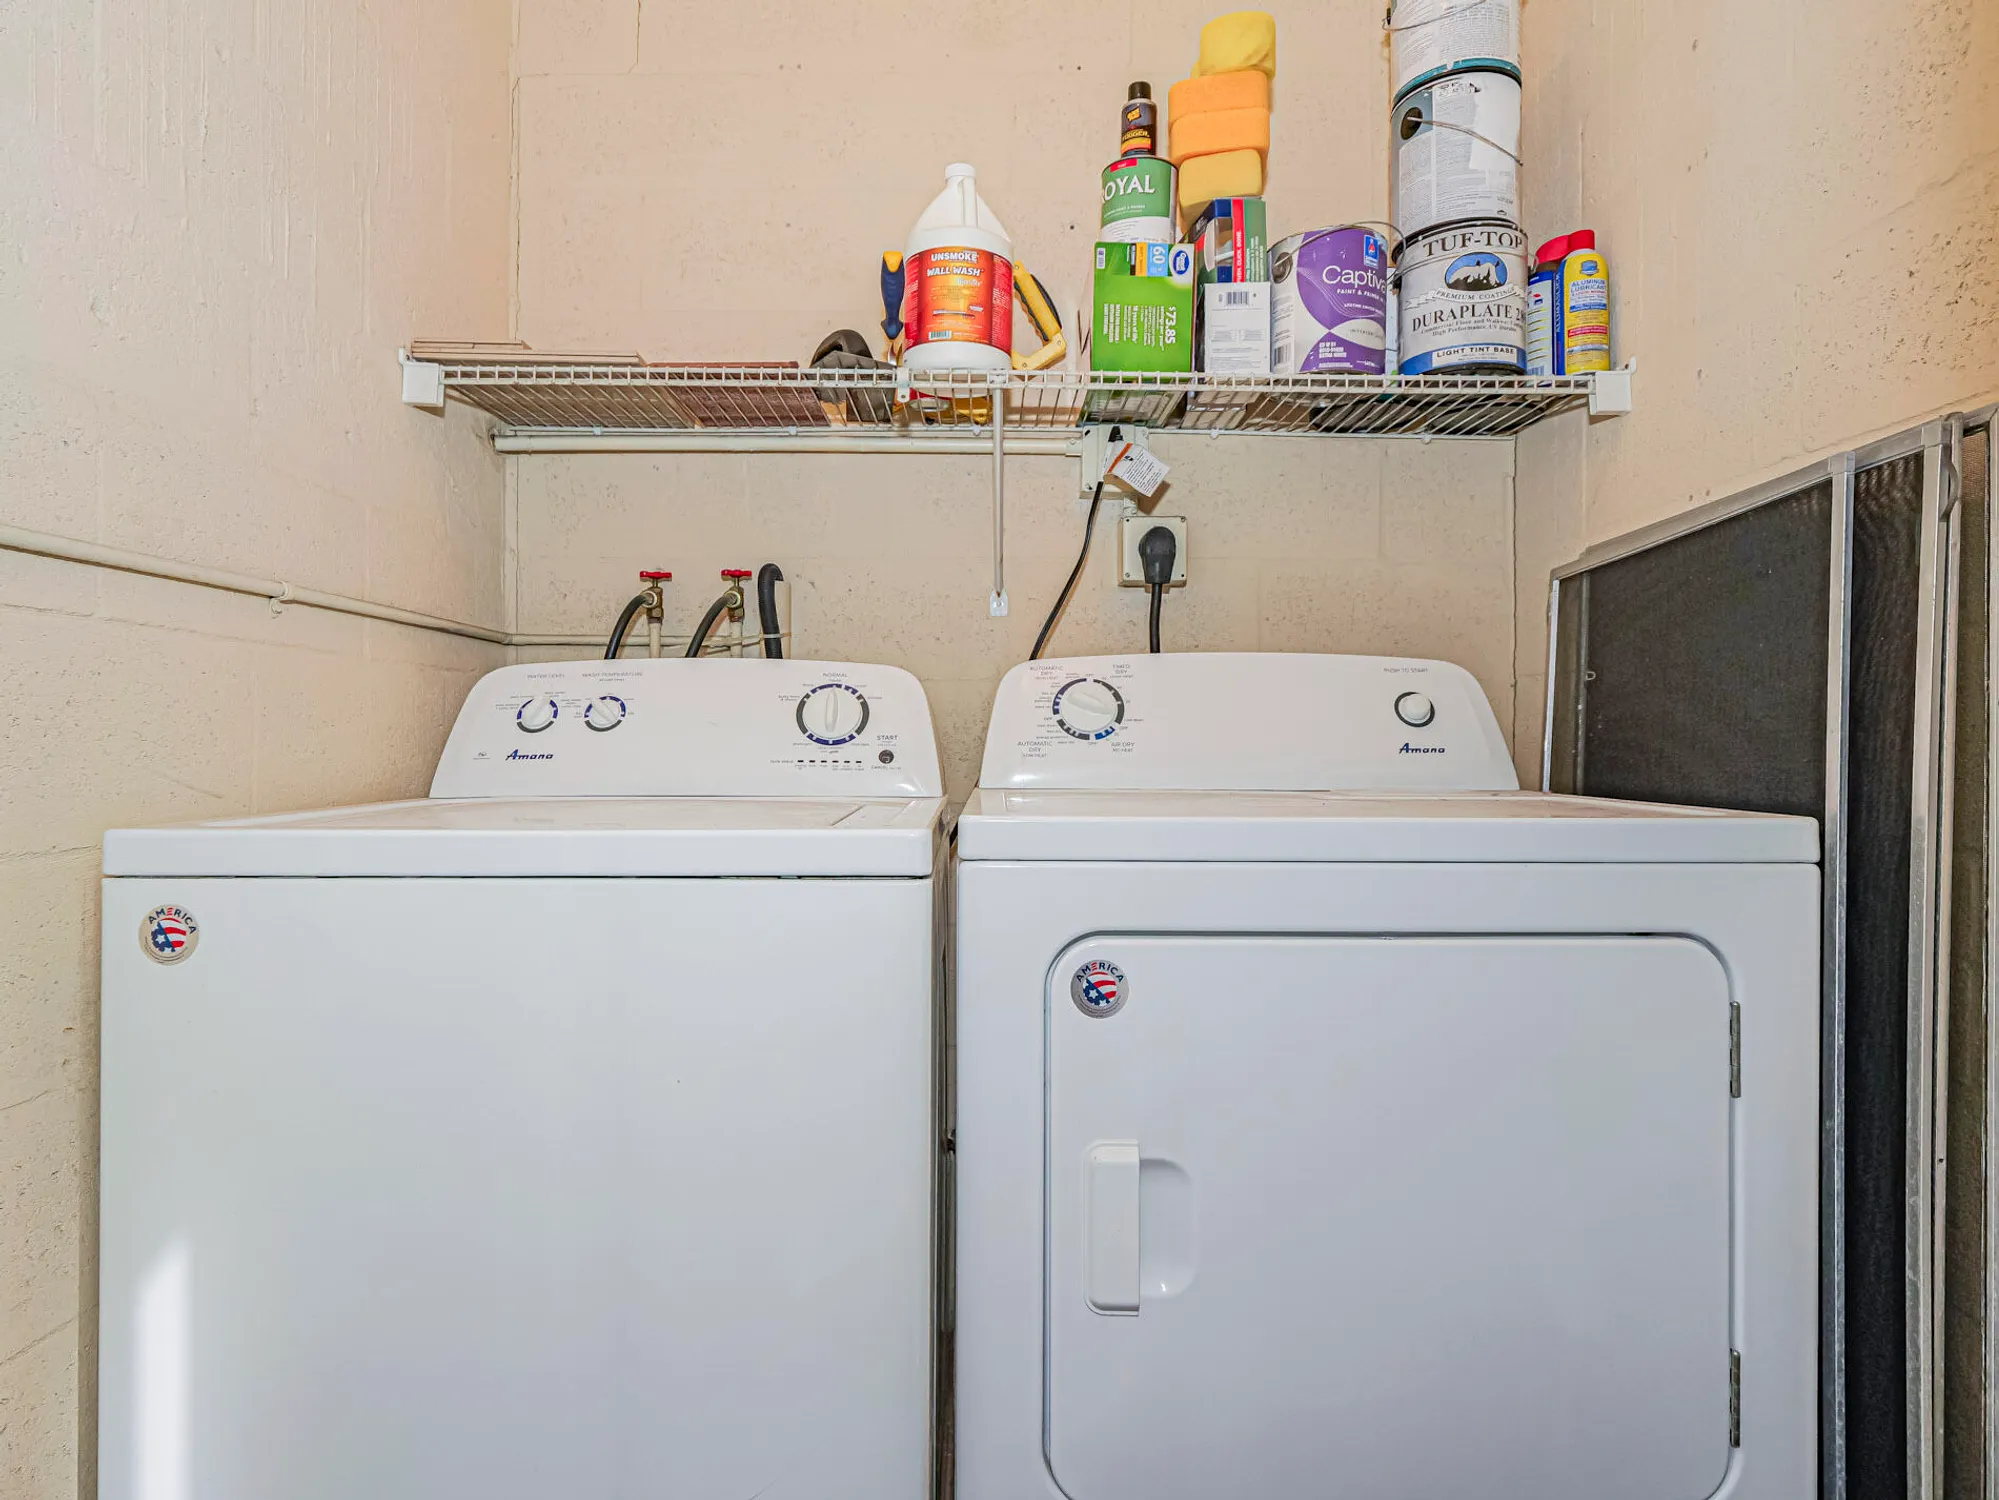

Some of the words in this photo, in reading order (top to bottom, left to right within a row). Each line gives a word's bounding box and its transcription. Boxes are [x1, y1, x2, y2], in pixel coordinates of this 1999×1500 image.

[1423, 231, 1523, 257] TUF-TOP
[931, 252, 977, 263] UNSMOKE
[1152, 246, 1166, 264] 60
[927, 267, 951, 277] WALL
[953, 266, 981, 276] WASH
[1436, 290, 1475, 300] PREMIUM
[1165, 305, 1177, 344] $73.85
[1412, 304, 1513, 332] DURAPLATE
[1436, 348, 1465, 358] LIGHT
[505, 749, 554, 761] Amana
[1398, 742, 1446, 754] Amana
[148, 907, 197, 935] AMERICA
[1076, 961, 1124, 983] AMERICA
